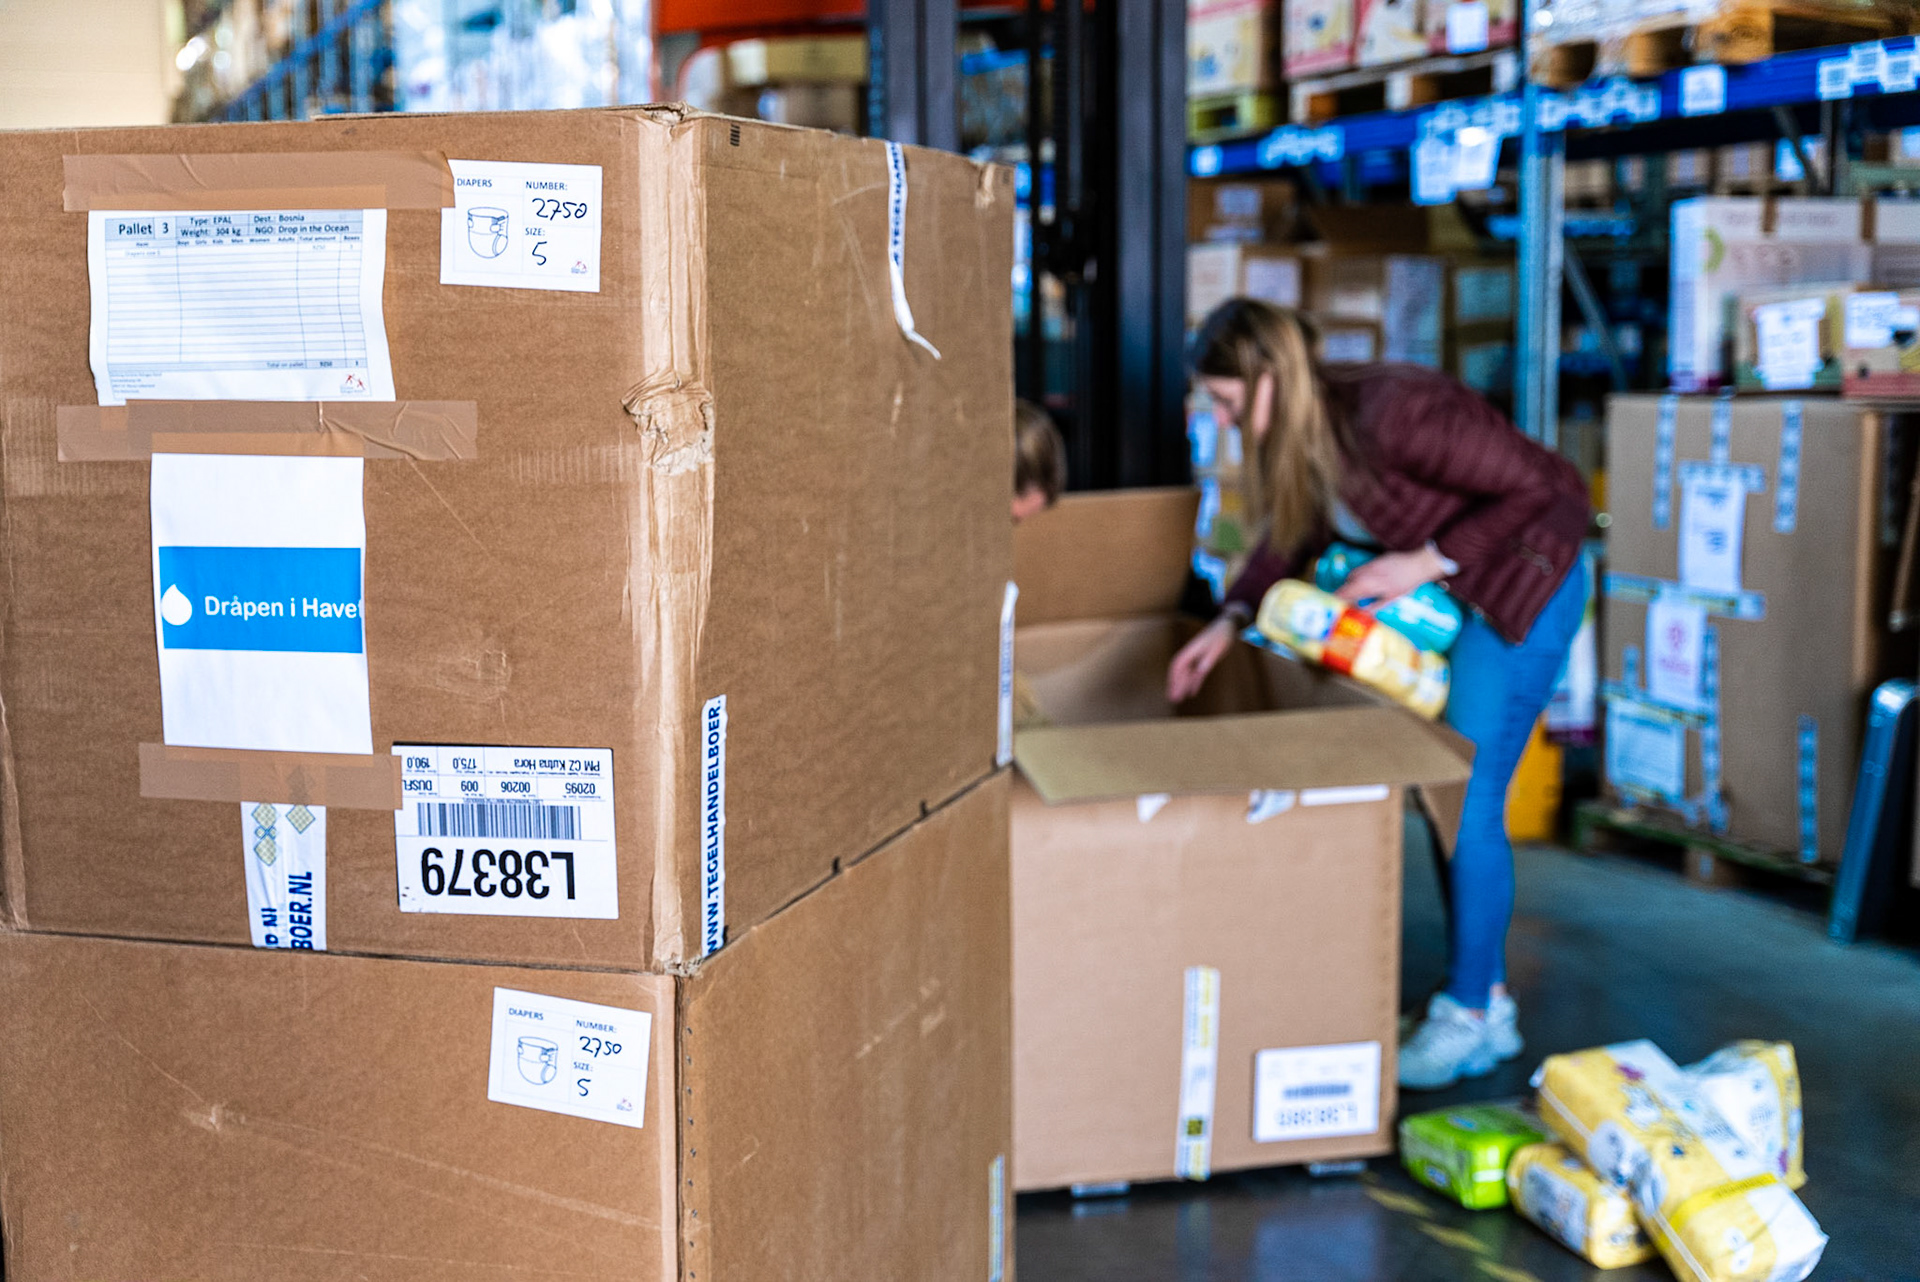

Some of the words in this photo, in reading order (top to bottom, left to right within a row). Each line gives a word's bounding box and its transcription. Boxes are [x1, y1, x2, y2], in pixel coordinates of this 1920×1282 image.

[456, 178, 493, 188] DIAPERS
[525, 181, 568, 191] NUMBER:
[531, 197, 588, 221] 2750
[278, 213, 305, 222] Bosnia
[118, 223, 153, 235] Pallet
[162, 221, 170, 234] 3
[180, 227, 209, 238] Weight:
[231, 227, 242, 237] kg
[278, 225, 298, 234] Drop
[299, 224, 308, 233] in
[309, 224, 322, 232] the
[324, 224, 350, 232] Ocean
[525, 227, 545, 237] SIZE:
[531, 240, 548, 266] 5
[204, 595, 284, 621] Dråpen
[290, 597, 296, 617] i
[513, 758, 537, 770] Hora
[538, 759, 566, 771] Kutna
[568, 759, 582, 772] CZ
[583, 760, 601, 772] PM
[460, 780, 479, 791] 009
[500, 781, 531, 793] 00206
[565, 782, 596, 794] 02095
[421, 847, 576, 900] L38379
[288, 871, 313, 950] BOER.NL
[508, 1007, 545, 1021] DIAPERS
[575, 1019, 617, 1034] NUMBER:
[579, 1036, 622, 1058] 2750
[573, 1061, 593, 1072] SIZE:
